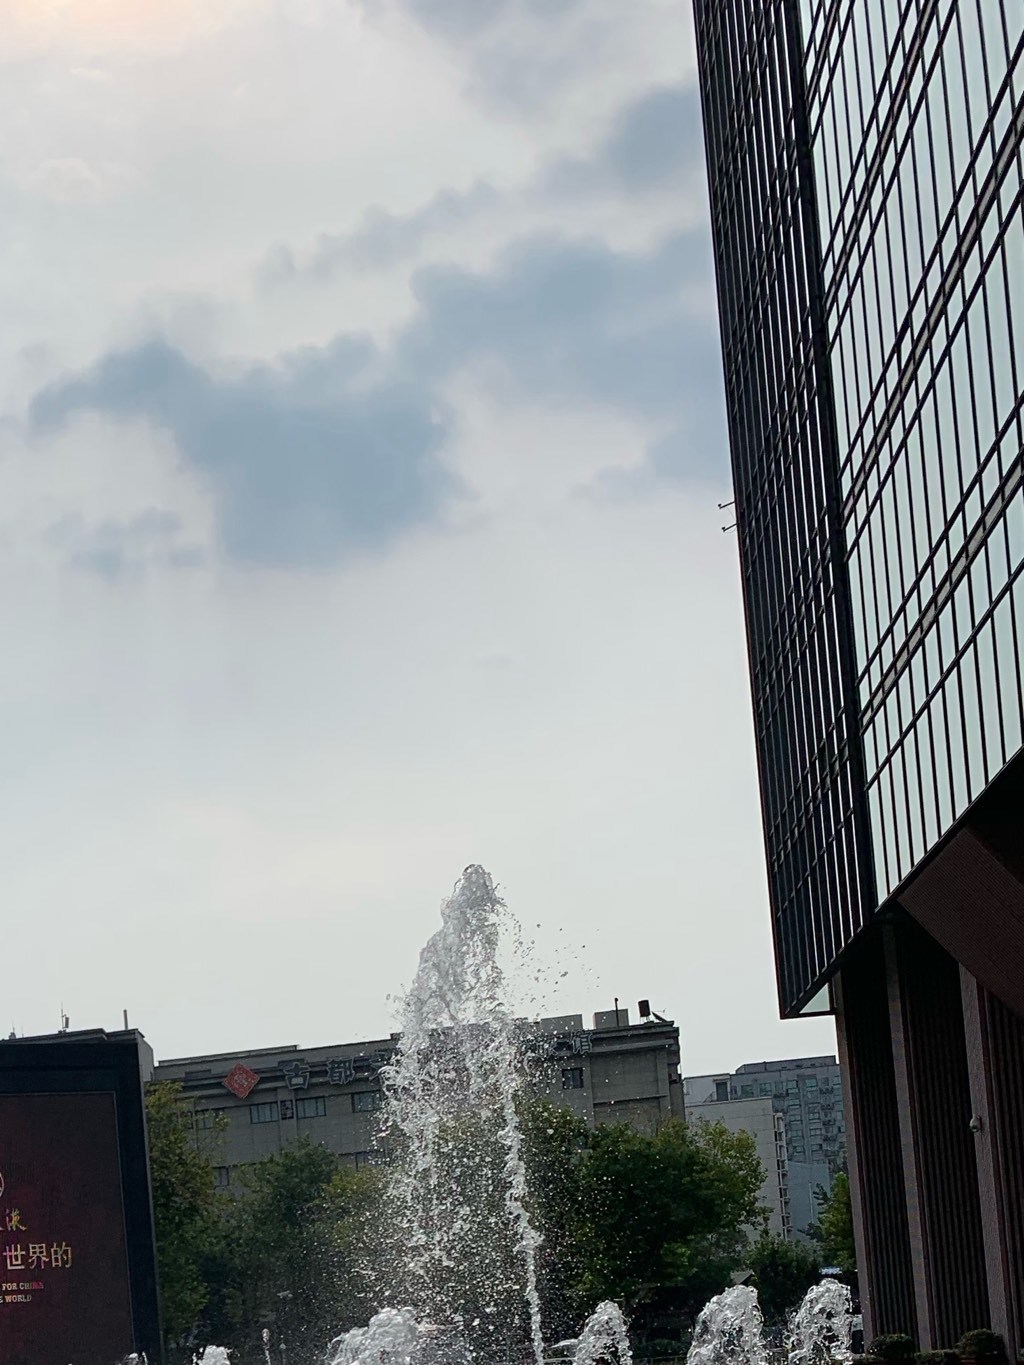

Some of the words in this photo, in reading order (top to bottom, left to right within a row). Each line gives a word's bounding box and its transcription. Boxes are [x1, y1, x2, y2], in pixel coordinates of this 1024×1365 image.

[2, 1241, 73, 1270] 世界的
[1, 1282, 18, 1292] FOR
[4, 1294, 33, 1303] WORLD
